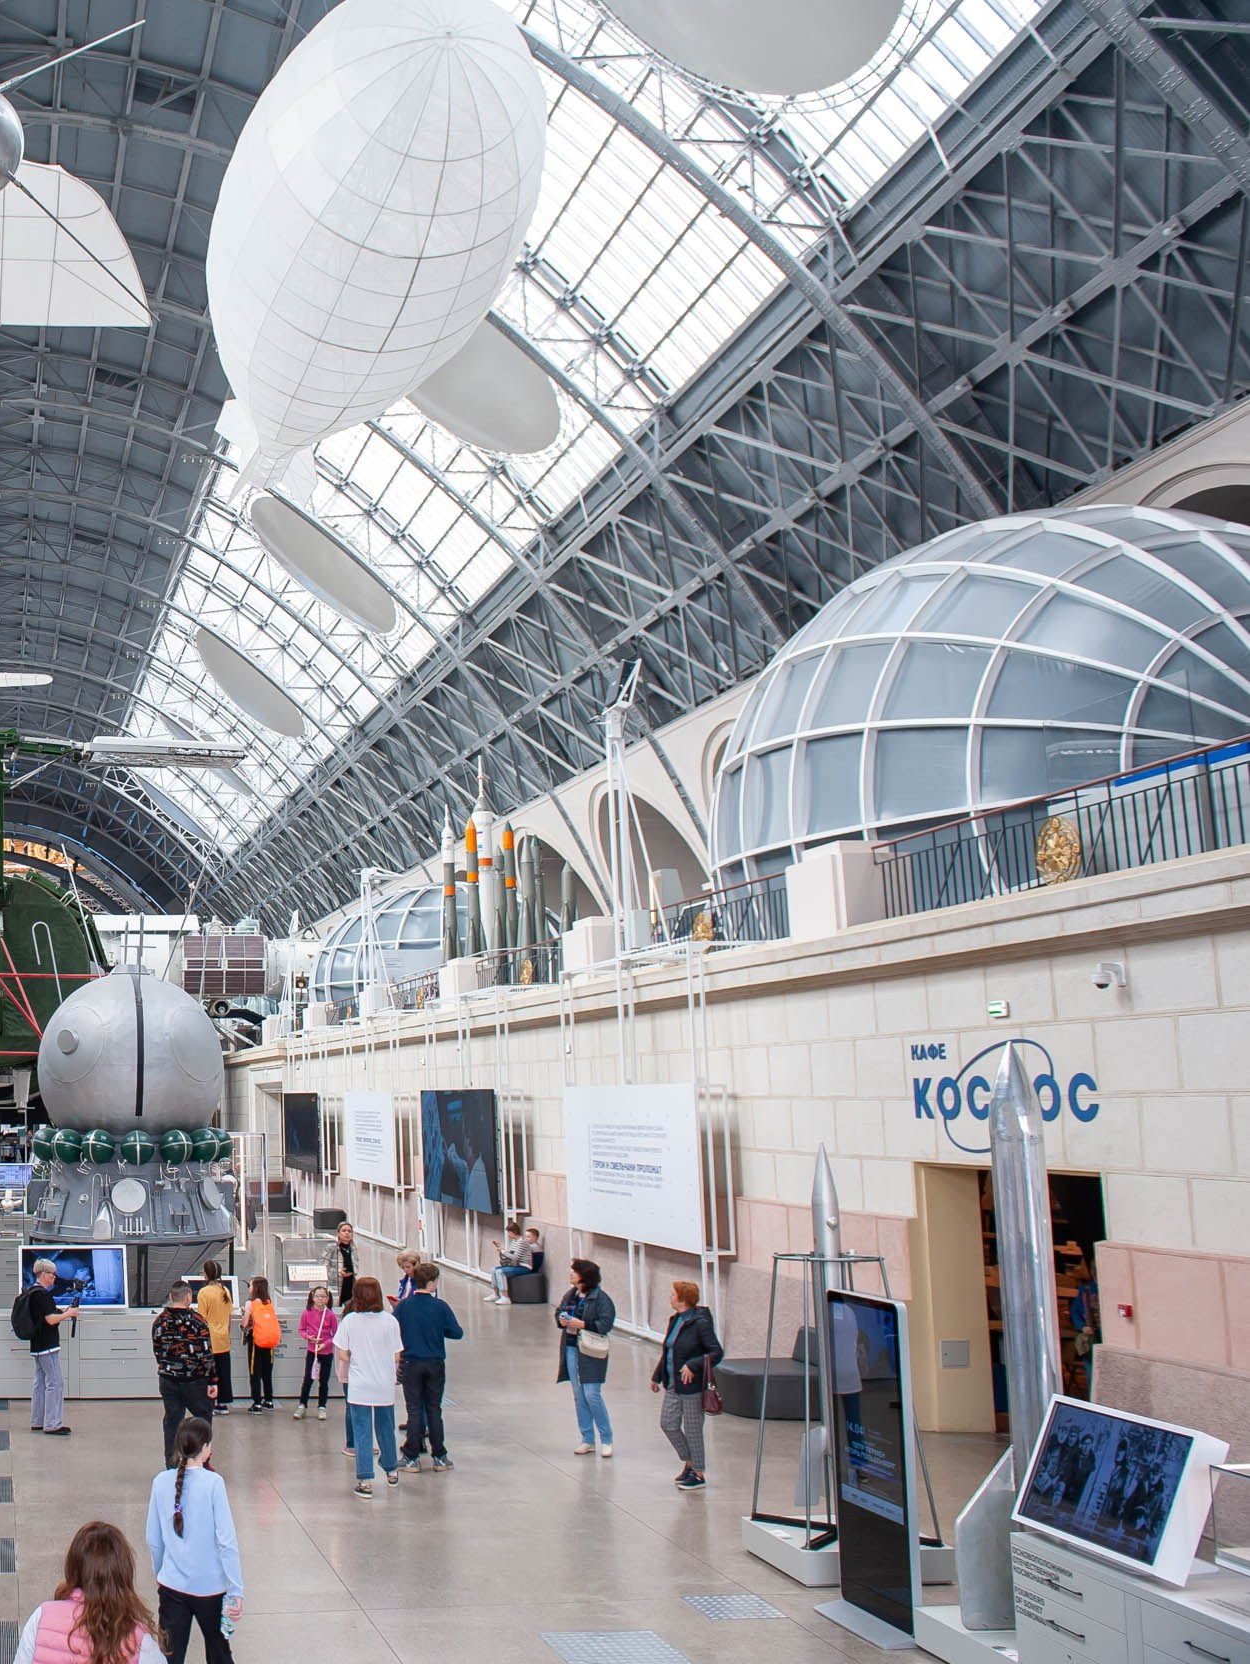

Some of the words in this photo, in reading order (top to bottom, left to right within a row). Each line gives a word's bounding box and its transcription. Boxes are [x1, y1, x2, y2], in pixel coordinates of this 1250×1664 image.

[911, 1043, 947, 1061] КАФЕ
[913, 1072, 1099, 1122] КОСОС
[1014, 1585, 1046, 1606] FOUNDERS
